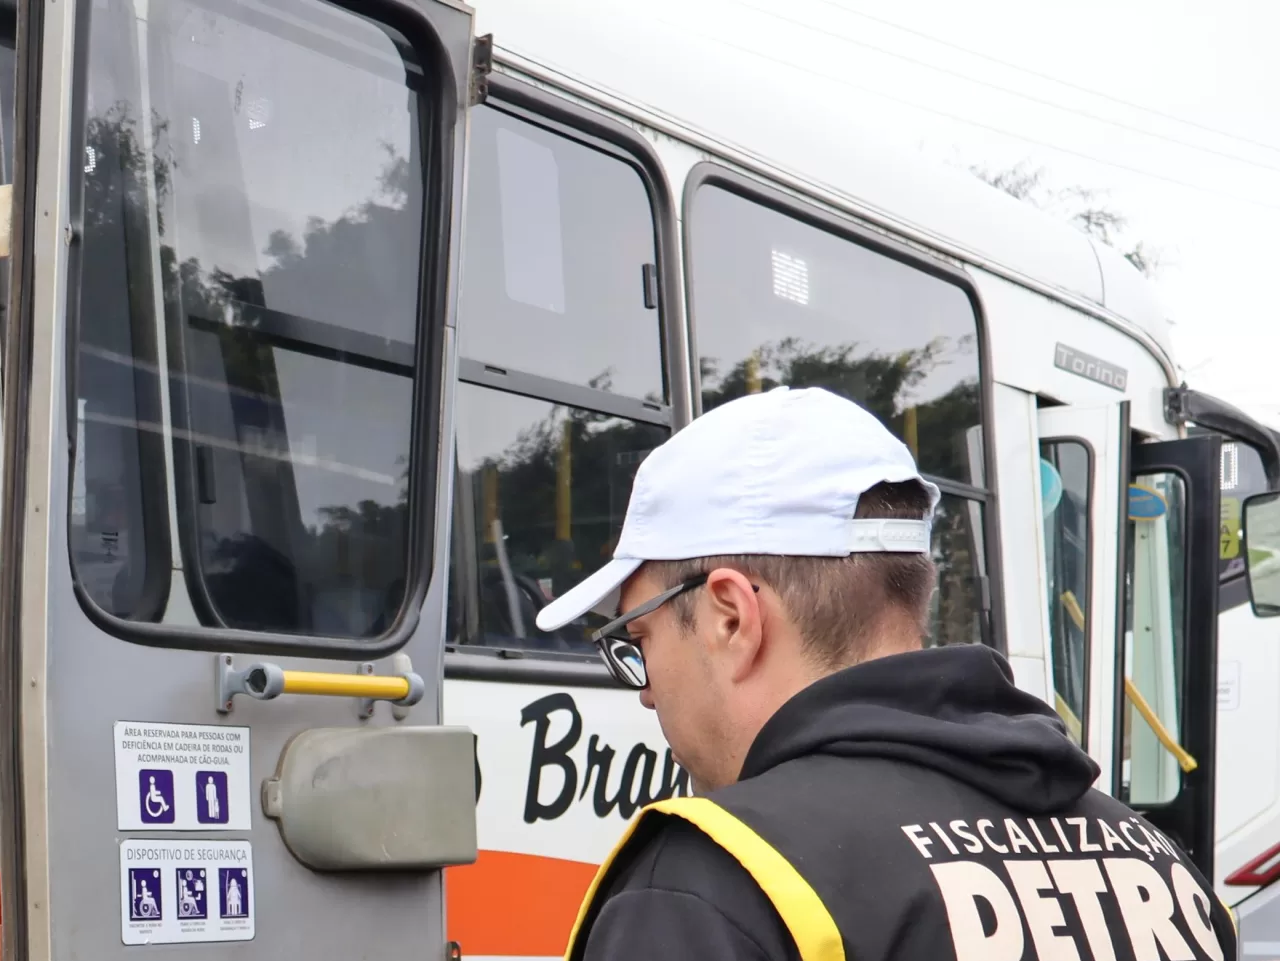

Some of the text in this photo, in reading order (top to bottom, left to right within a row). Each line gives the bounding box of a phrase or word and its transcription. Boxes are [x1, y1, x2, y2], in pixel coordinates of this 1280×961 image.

[1057, 346, 1126, 388] Torino
[124, 727, 241, 741] ÁREA RESERVADA PARA PESSOAS COM
[122, 739, 244, 754] DEFICIÊNCIA EM CADEIRA DE RODAS OU
[137, 754, 188, 764] ACOMPANHADA
[189, 756, 197, 764] DE
[127, 848, 247, 863] DISPOSITIVO DE SEGURANÇA
